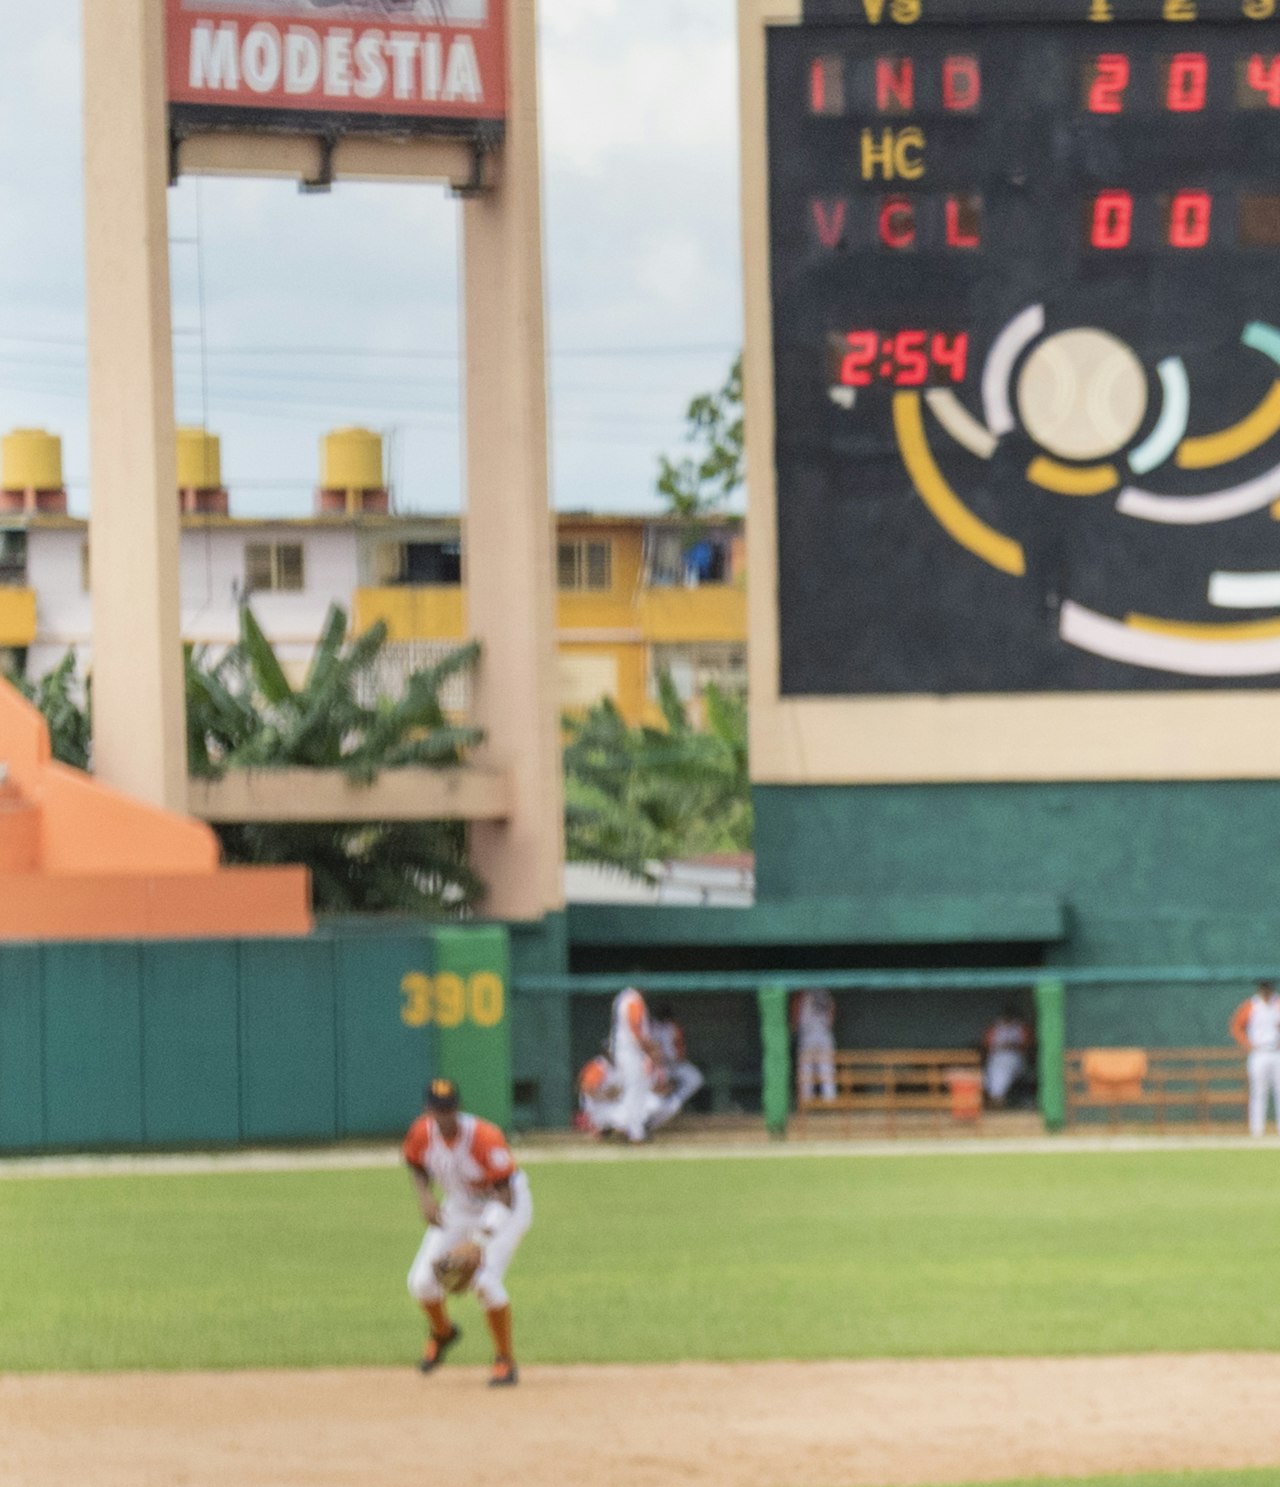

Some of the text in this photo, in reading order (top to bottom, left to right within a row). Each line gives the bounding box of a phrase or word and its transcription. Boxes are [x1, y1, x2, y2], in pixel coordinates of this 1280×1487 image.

[189, 18, 486, 104] MODESTIA
[1088, 53, 1130, 114] 2
[1166, 52, 1209, 112] 0
[860, 129, 926, 181] HC
[1090, 189, 1133, 249] 0
[1169, 189, 1212, 249] 0
[840, 329, 968, 387] 2:54
[400, 970, 504, 1027] 390
